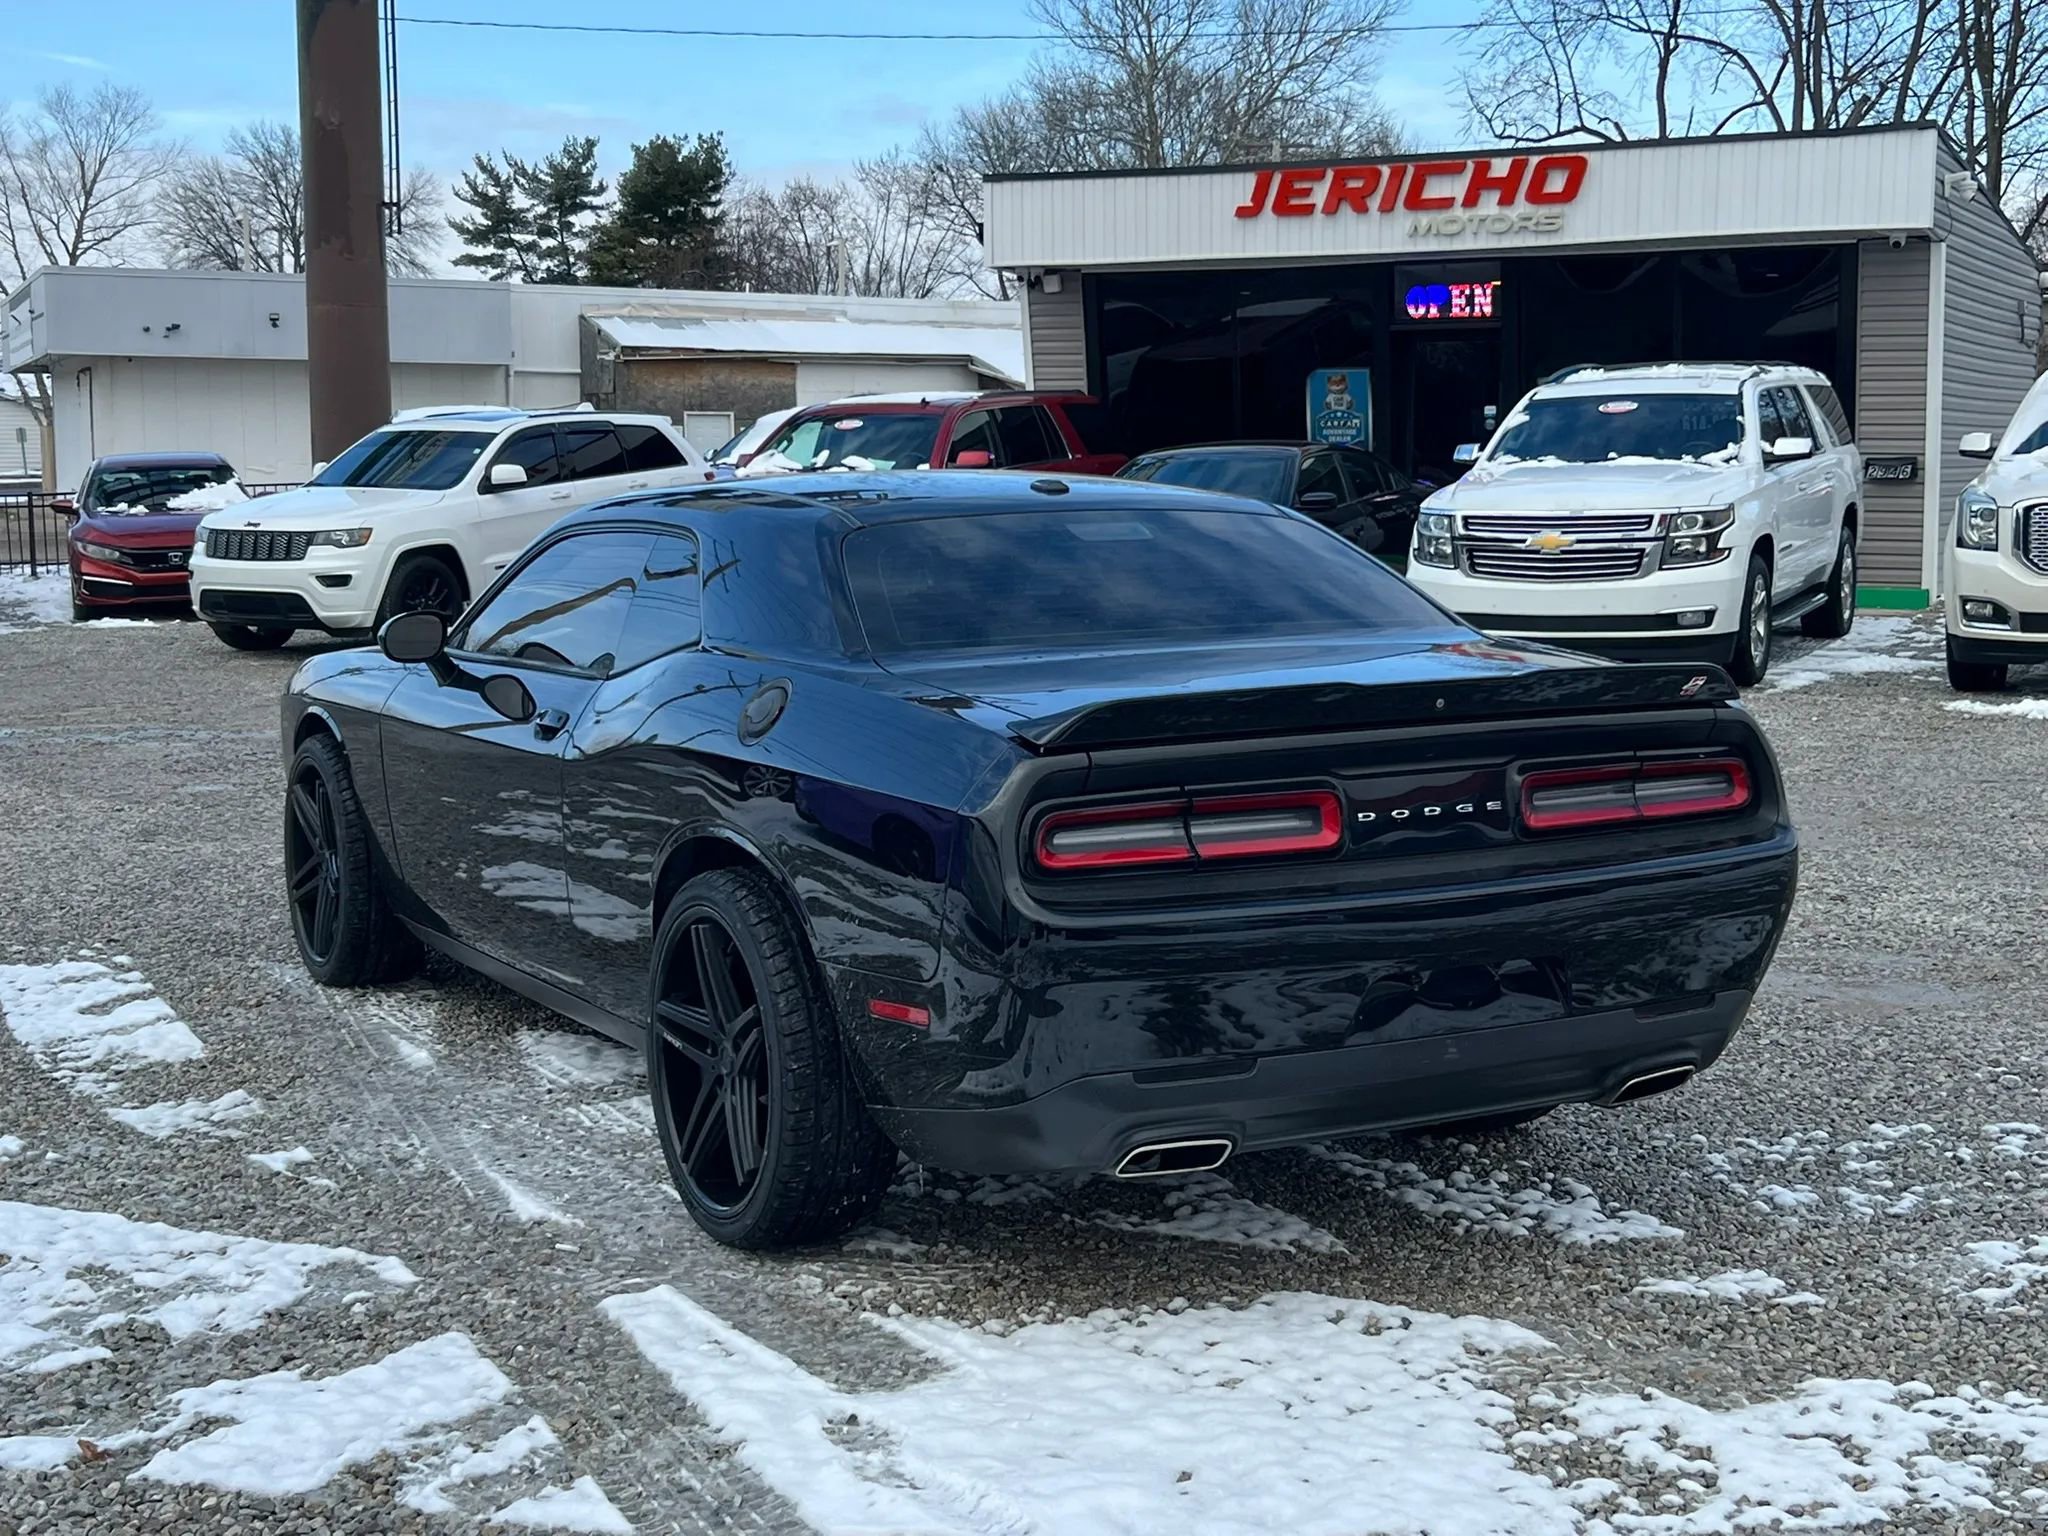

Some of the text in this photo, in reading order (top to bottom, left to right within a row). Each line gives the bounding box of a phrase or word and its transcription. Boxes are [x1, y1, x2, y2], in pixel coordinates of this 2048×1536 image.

[1234, 154, 1589, 219] JERICHO
[1407, 211, 1564, 238] MOTORS
[1405, 283, 1494, 319] OPEN
[1357, 800, 1503, 822] DODGE
